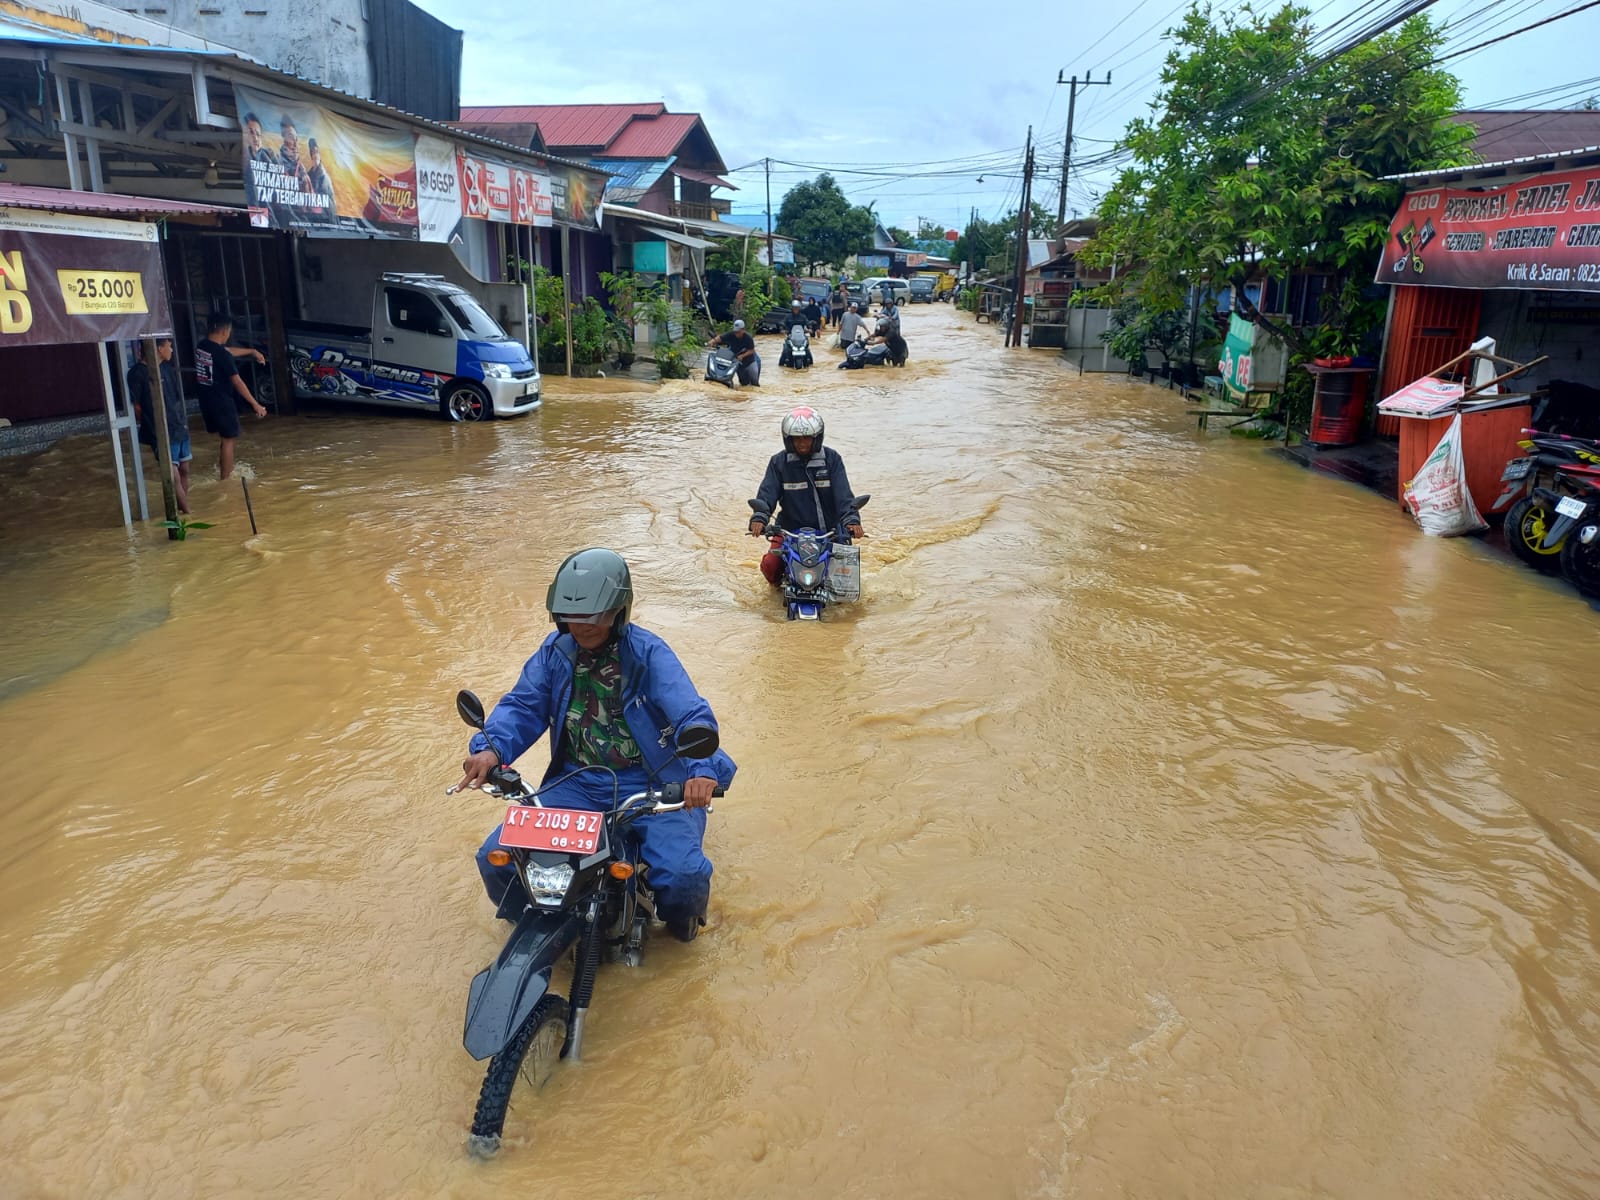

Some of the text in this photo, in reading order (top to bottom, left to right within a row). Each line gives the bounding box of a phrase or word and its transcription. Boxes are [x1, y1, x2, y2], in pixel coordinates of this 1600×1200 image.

[430, 170, 454, 194] GGSP
[257, 187, 330, 208] TAK TERGANTIKAN
[376, 176, 416, 219] Surya
[1440, 191, 1508, 223] BENGKEL
[1510, 182, 1571, 218] FADEL
[1446, 232, 1483, 252] SERVICE
[1539, 263, 1571, 281] Saran
[1577, 263, 1600, 283] 0823
[507, 810, 599, 833] KT 2109 BZ
